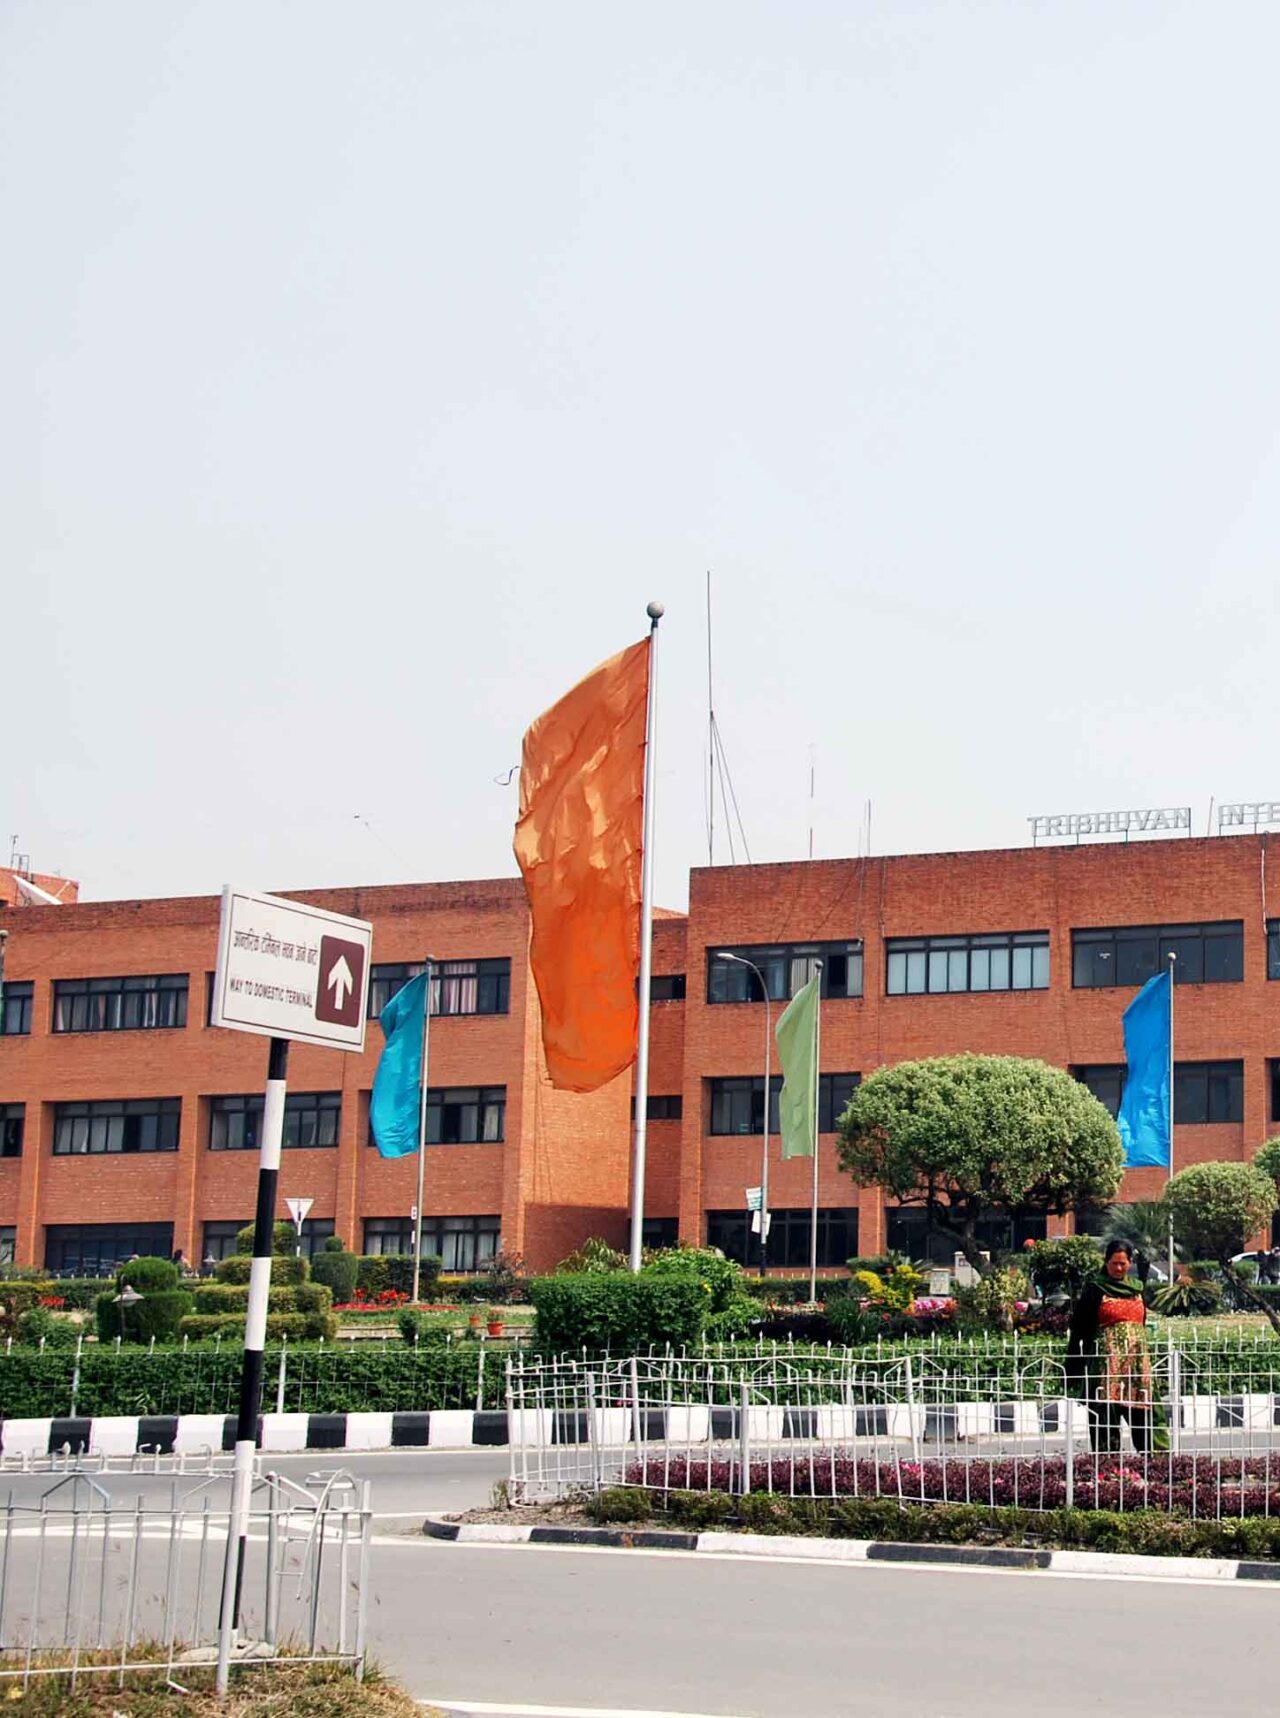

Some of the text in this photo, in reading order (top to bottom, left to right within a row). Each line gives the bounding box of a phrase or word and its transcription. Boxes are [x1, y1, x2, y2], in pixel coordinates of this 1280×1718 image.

[1027, 807, 1190, 837] TRIBHUVAN
[230, 978, 313, 1009] WAY TO DOMESTIC TERMINAL
